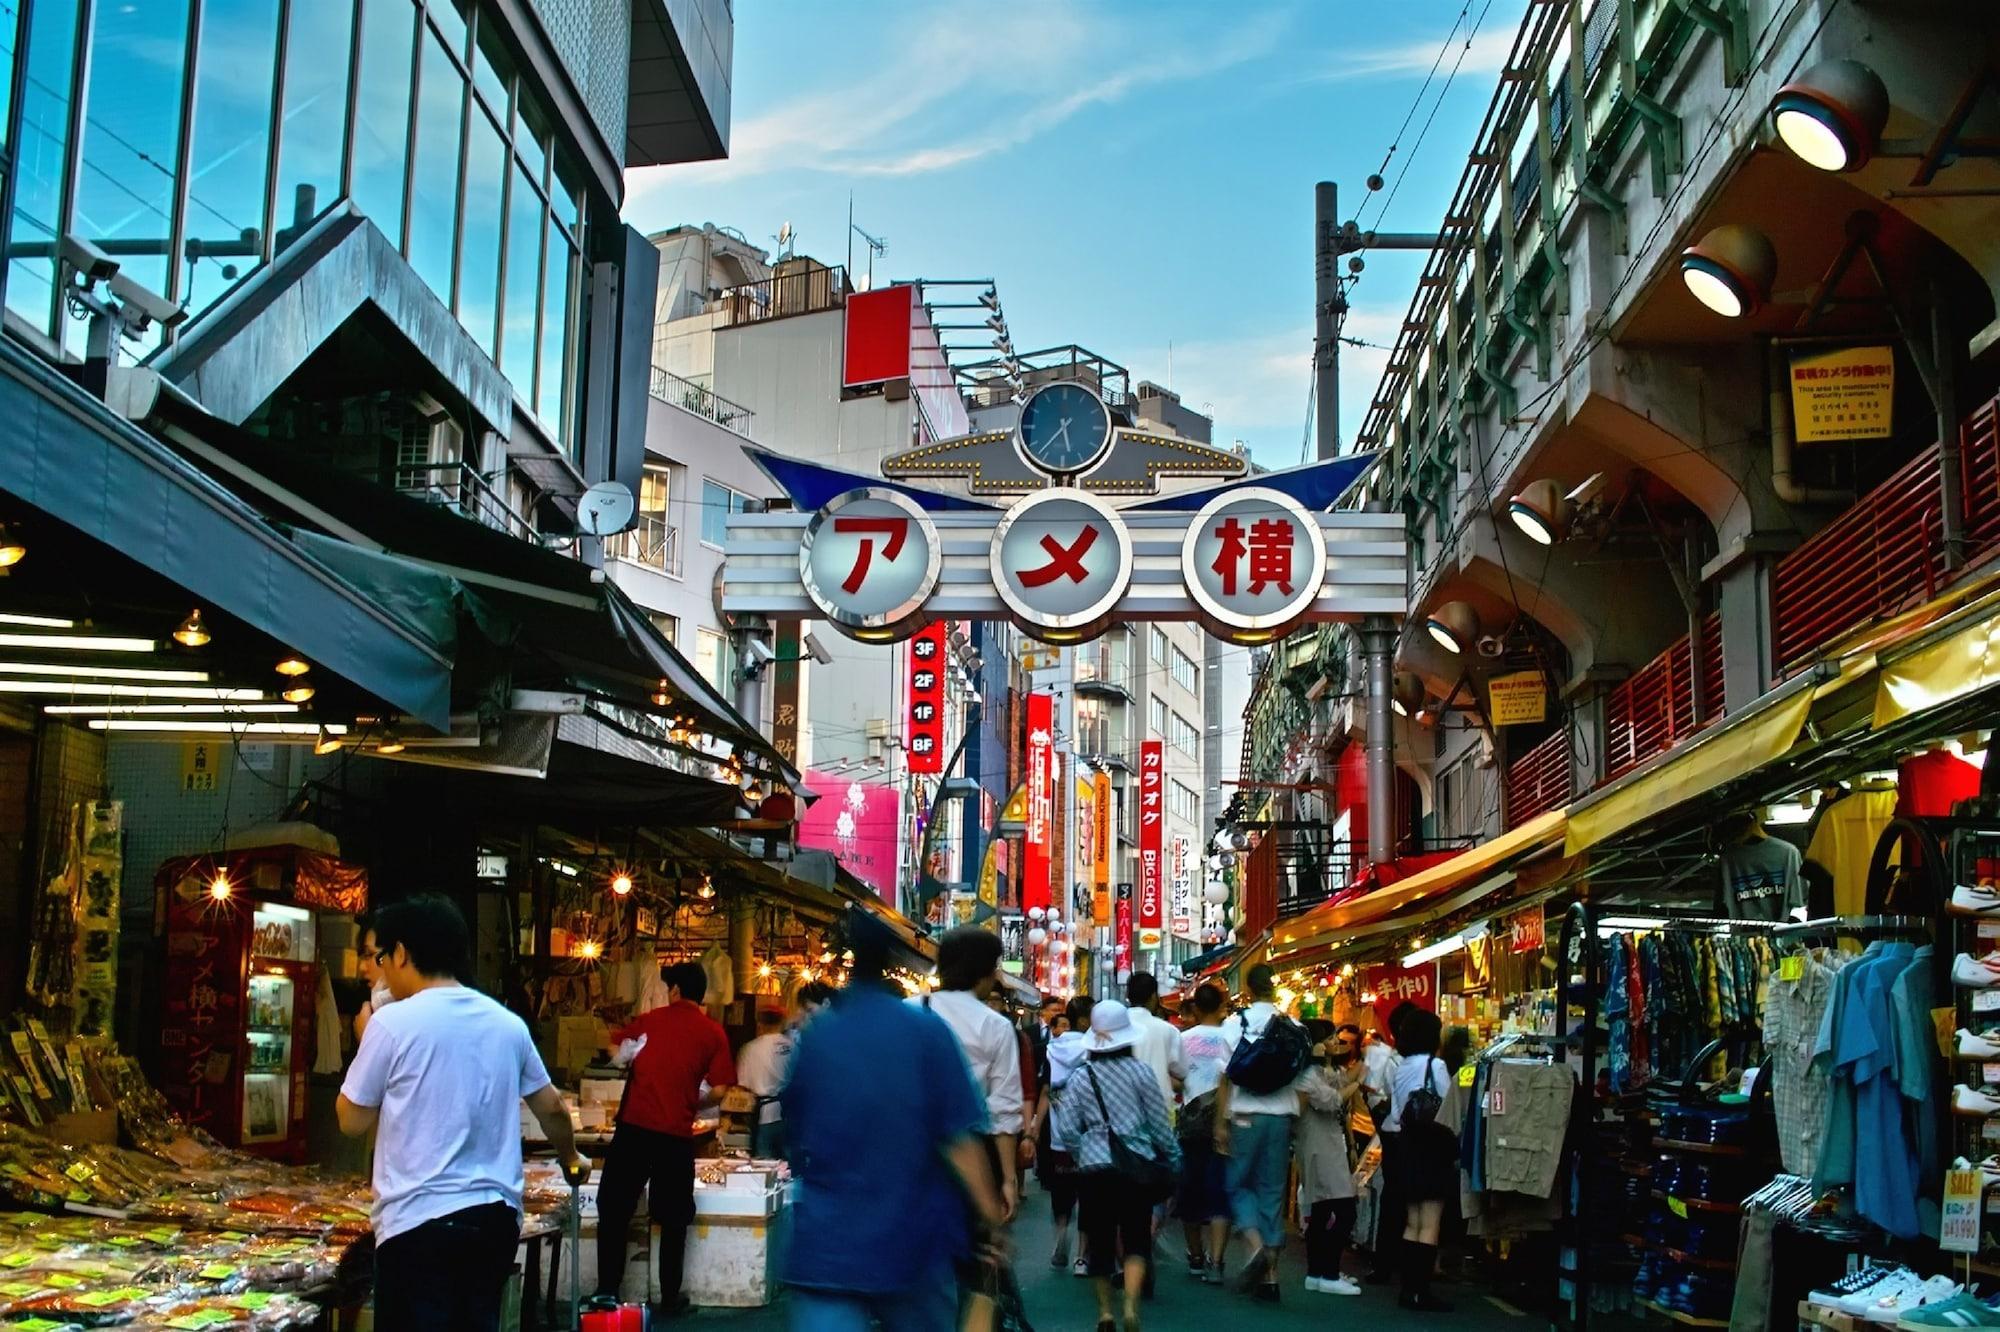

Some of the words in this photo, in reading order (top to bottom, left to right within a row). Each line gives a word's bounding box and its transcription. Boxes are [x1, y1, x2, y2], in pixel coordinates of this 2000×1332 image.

[834, 517, 1294, 597] アメ横
[915, 641, 935, 656] 3F
[914, 673, 934, 688] 2F
[913, 705, 933, 720] 1F
[912, 738, 933, 753] BF
[1033, 747, 1049, 844] GAME
[1142, 751, 1160, 826] カラオケ
[1377, 975, 1429, 1000] 手作り
[1950, 1173, 1974, 1195] SALE
